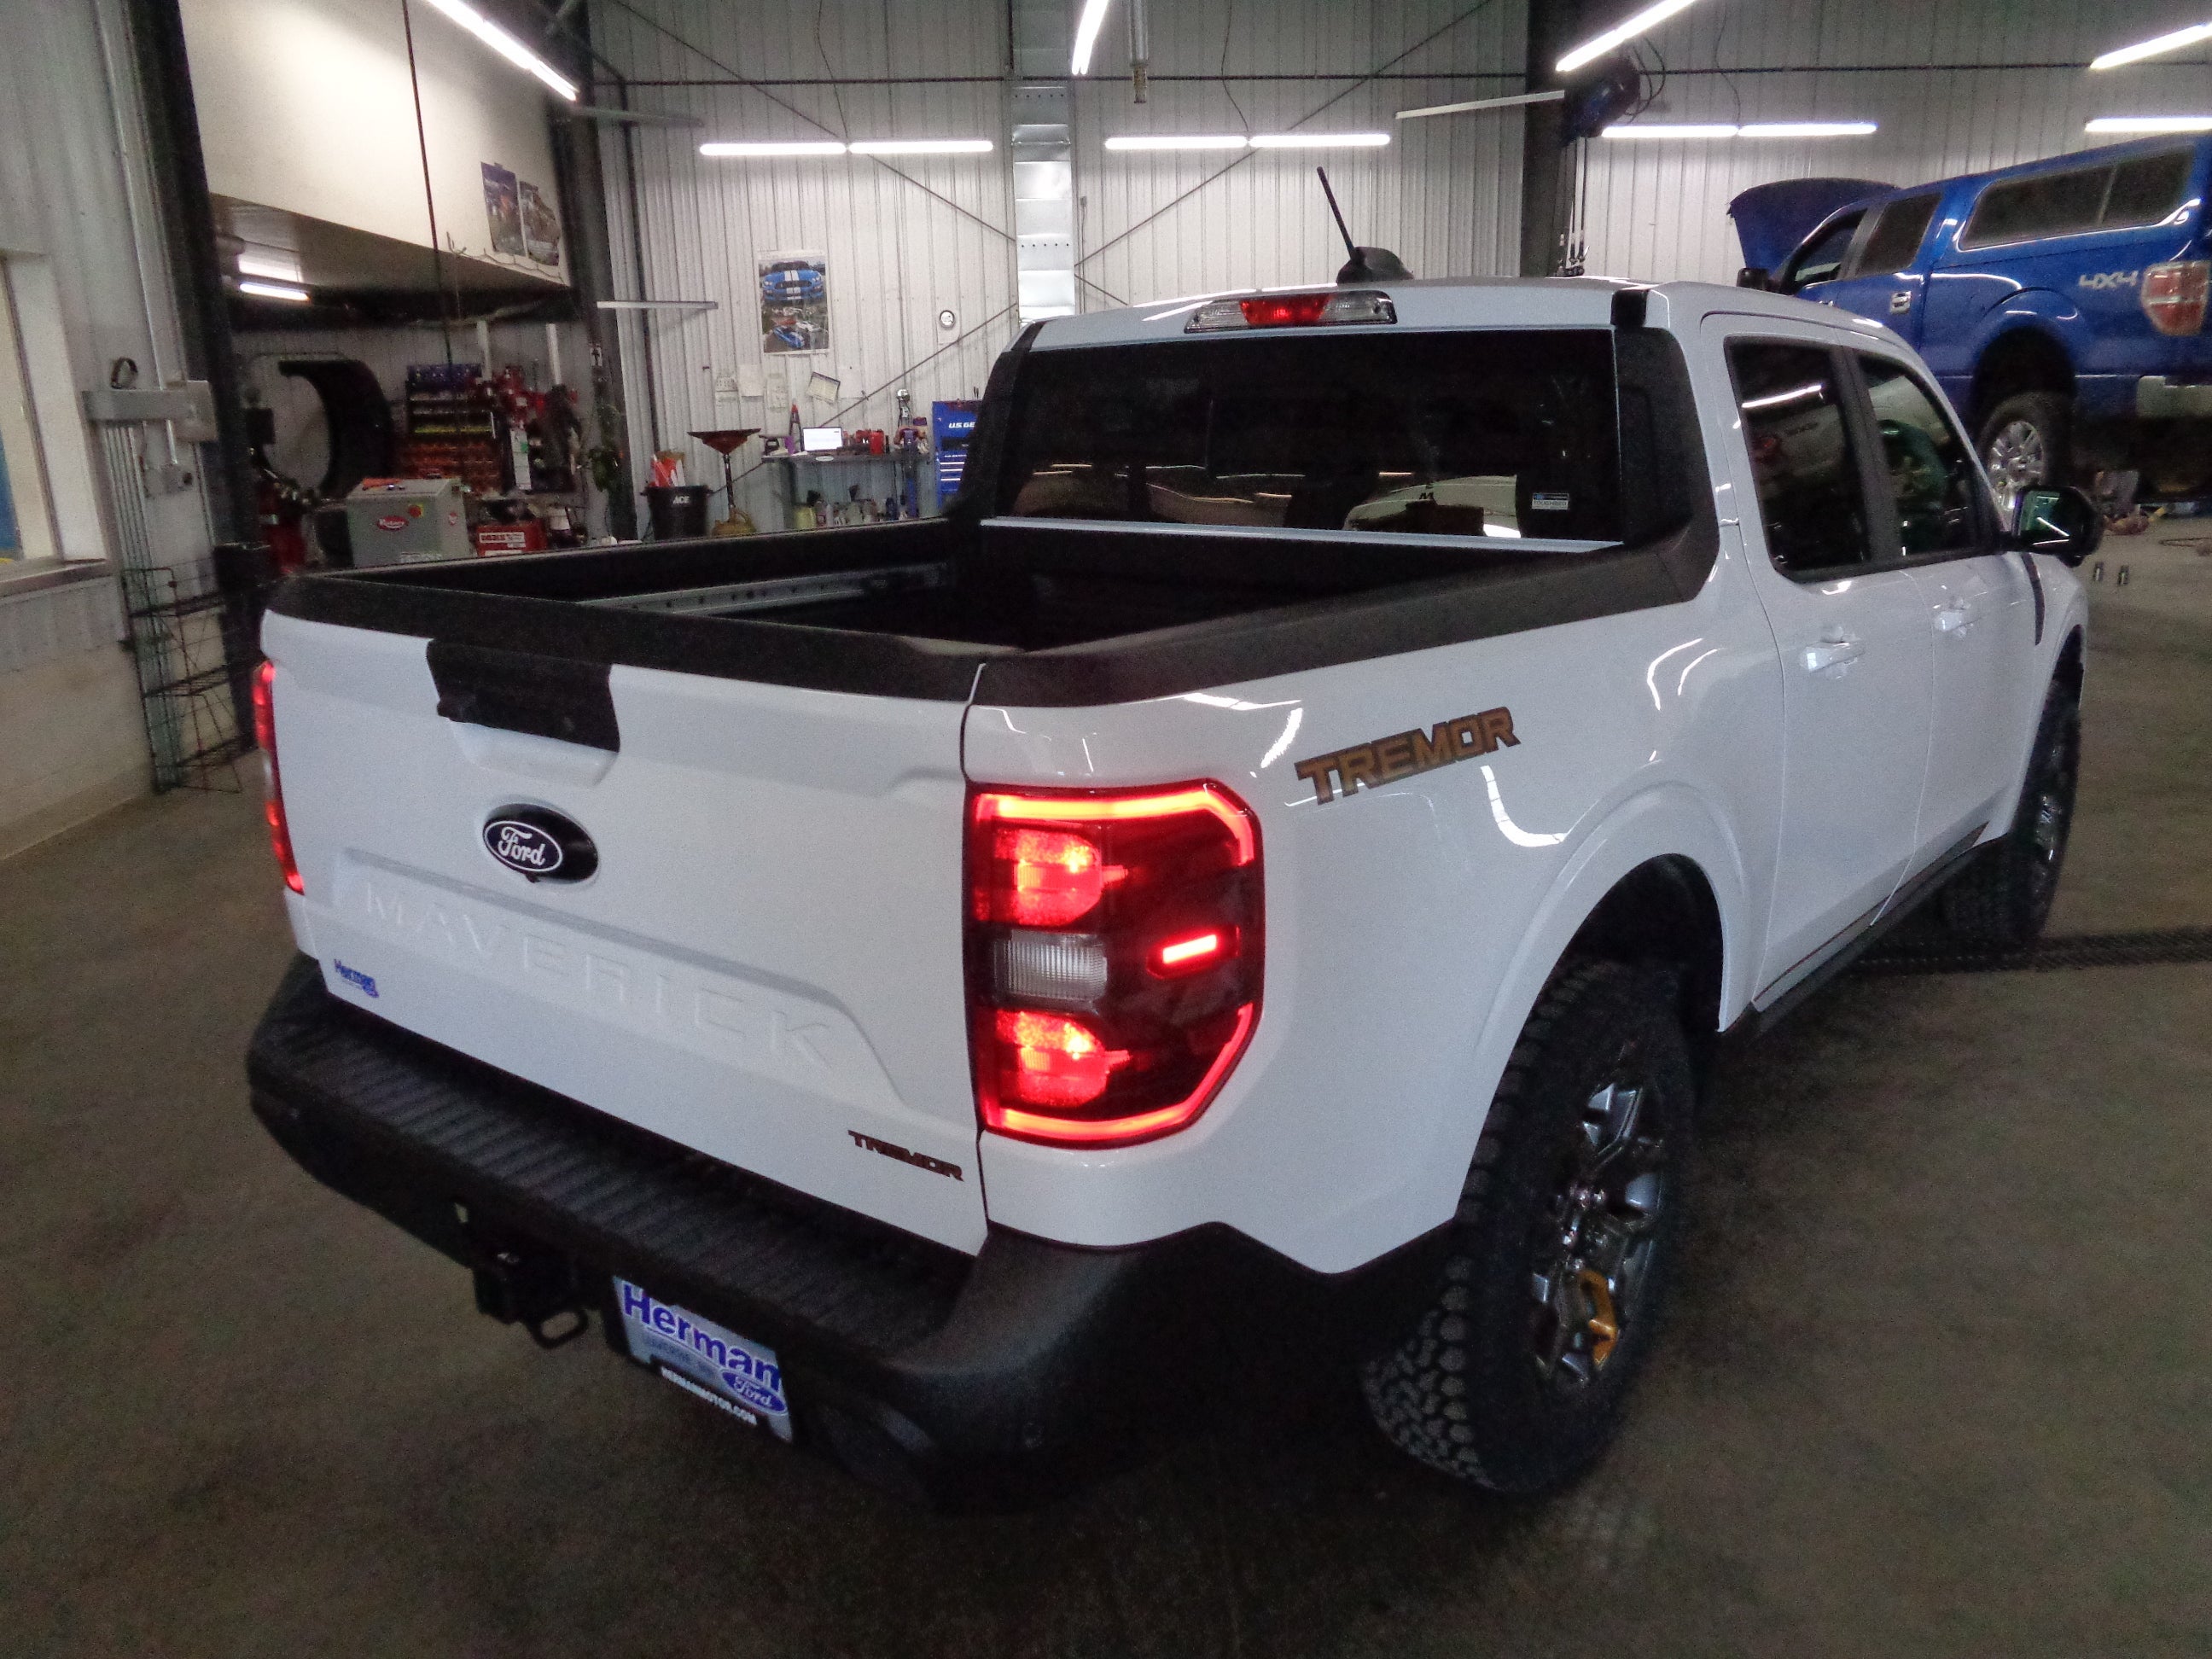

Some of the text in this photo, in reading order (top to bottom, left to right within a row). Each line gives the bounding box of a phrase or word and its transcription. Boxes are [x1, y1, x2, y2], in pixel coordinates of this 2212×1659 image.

[2078, 270, 2139, 289] 4X4
[672, 495, 690, 504] ACE
[1294, 706, 1521, 805] TREMOR
[498, 826, 546, 866] Ford
[366, 882, 830, 1068] MAVERICK
[847, 1129, 964, 1182] TREMOR
[622, 1284, 783, 1392] Herman
[733, 1376, 774, 1409] Ford
